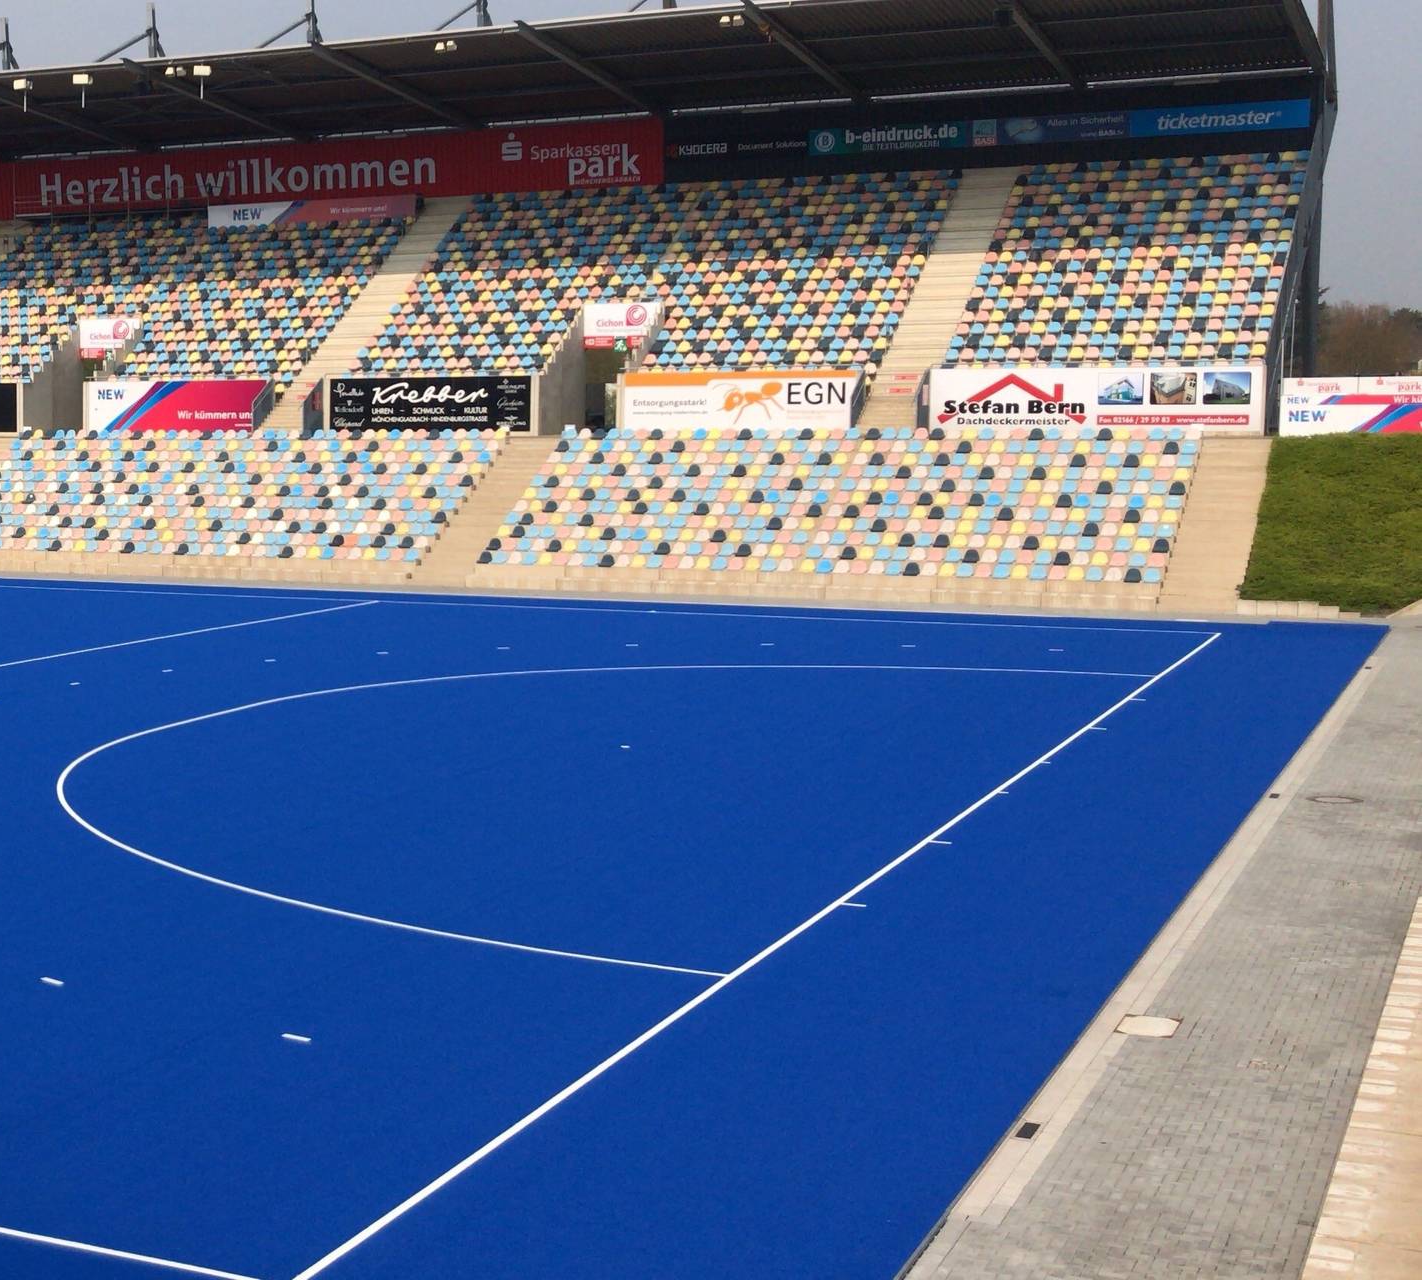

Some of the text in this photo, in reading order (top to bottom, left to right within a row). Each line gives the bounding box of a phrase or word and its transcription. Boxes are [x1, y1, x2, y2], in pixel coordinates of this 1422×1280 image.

[844, 123, 958, 145] b-eindruck.de
[530, 142, 621, 163] Sparkassen
[678, 142, 728, 156] KYOCERA
[568, 143, 641, 185] park
[40, 156, 437, 207] Herzlich willkommen
[232, 208, 263, 221] NEW
[329, 206, 341, 215] Wir
[596, 319, 624, 328] Cichon
[371, 382, 489, 405] Krebber
[786, 381, 847, 405] EGN
[1318, 383, 1341, 392] park
[97, 388, 125, 400] NEW
[1287, 396, 1310, 404] NEW
[632, 398, 708, 408] Entsorgungsstark!
[943, 400, 1086, 414] Stefan Bern
[178, 410, 192, 420] Wir
[194, 410, 237, 420] kümmern
[371, 406, 394, 415] UHREN
[412, 406, 445, 415] SCHMUCK
[464, 406, 488, 414] KULTUR
[1288, 410, 1327, 422] NEW
[957, 416, 1070, 425] Dachdeckermeister
